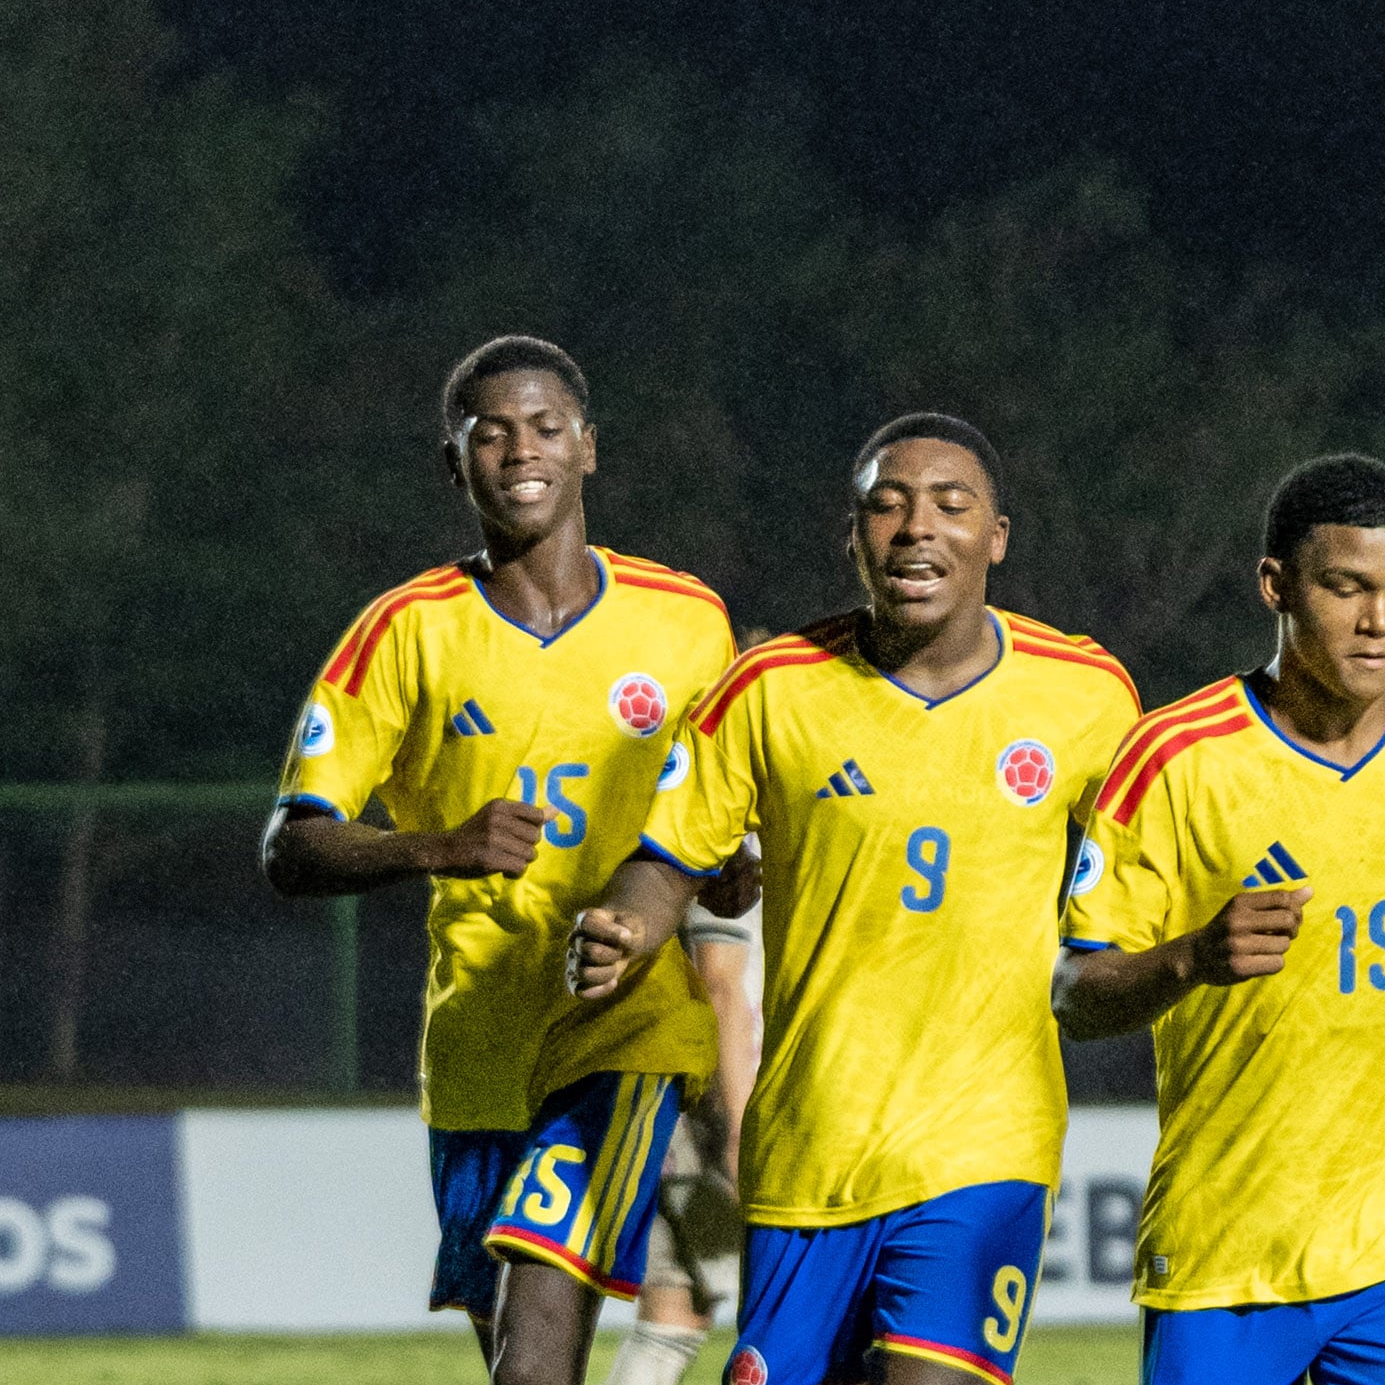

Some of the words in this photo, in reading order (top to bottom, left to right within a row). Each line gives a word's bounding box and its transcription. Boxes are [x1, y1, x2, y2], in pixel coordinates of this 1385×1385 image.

[901, 826, 950, 913] 9
[503, 1144, 587, 1226] 15
[983, 1265, 1027, 1352] 9
